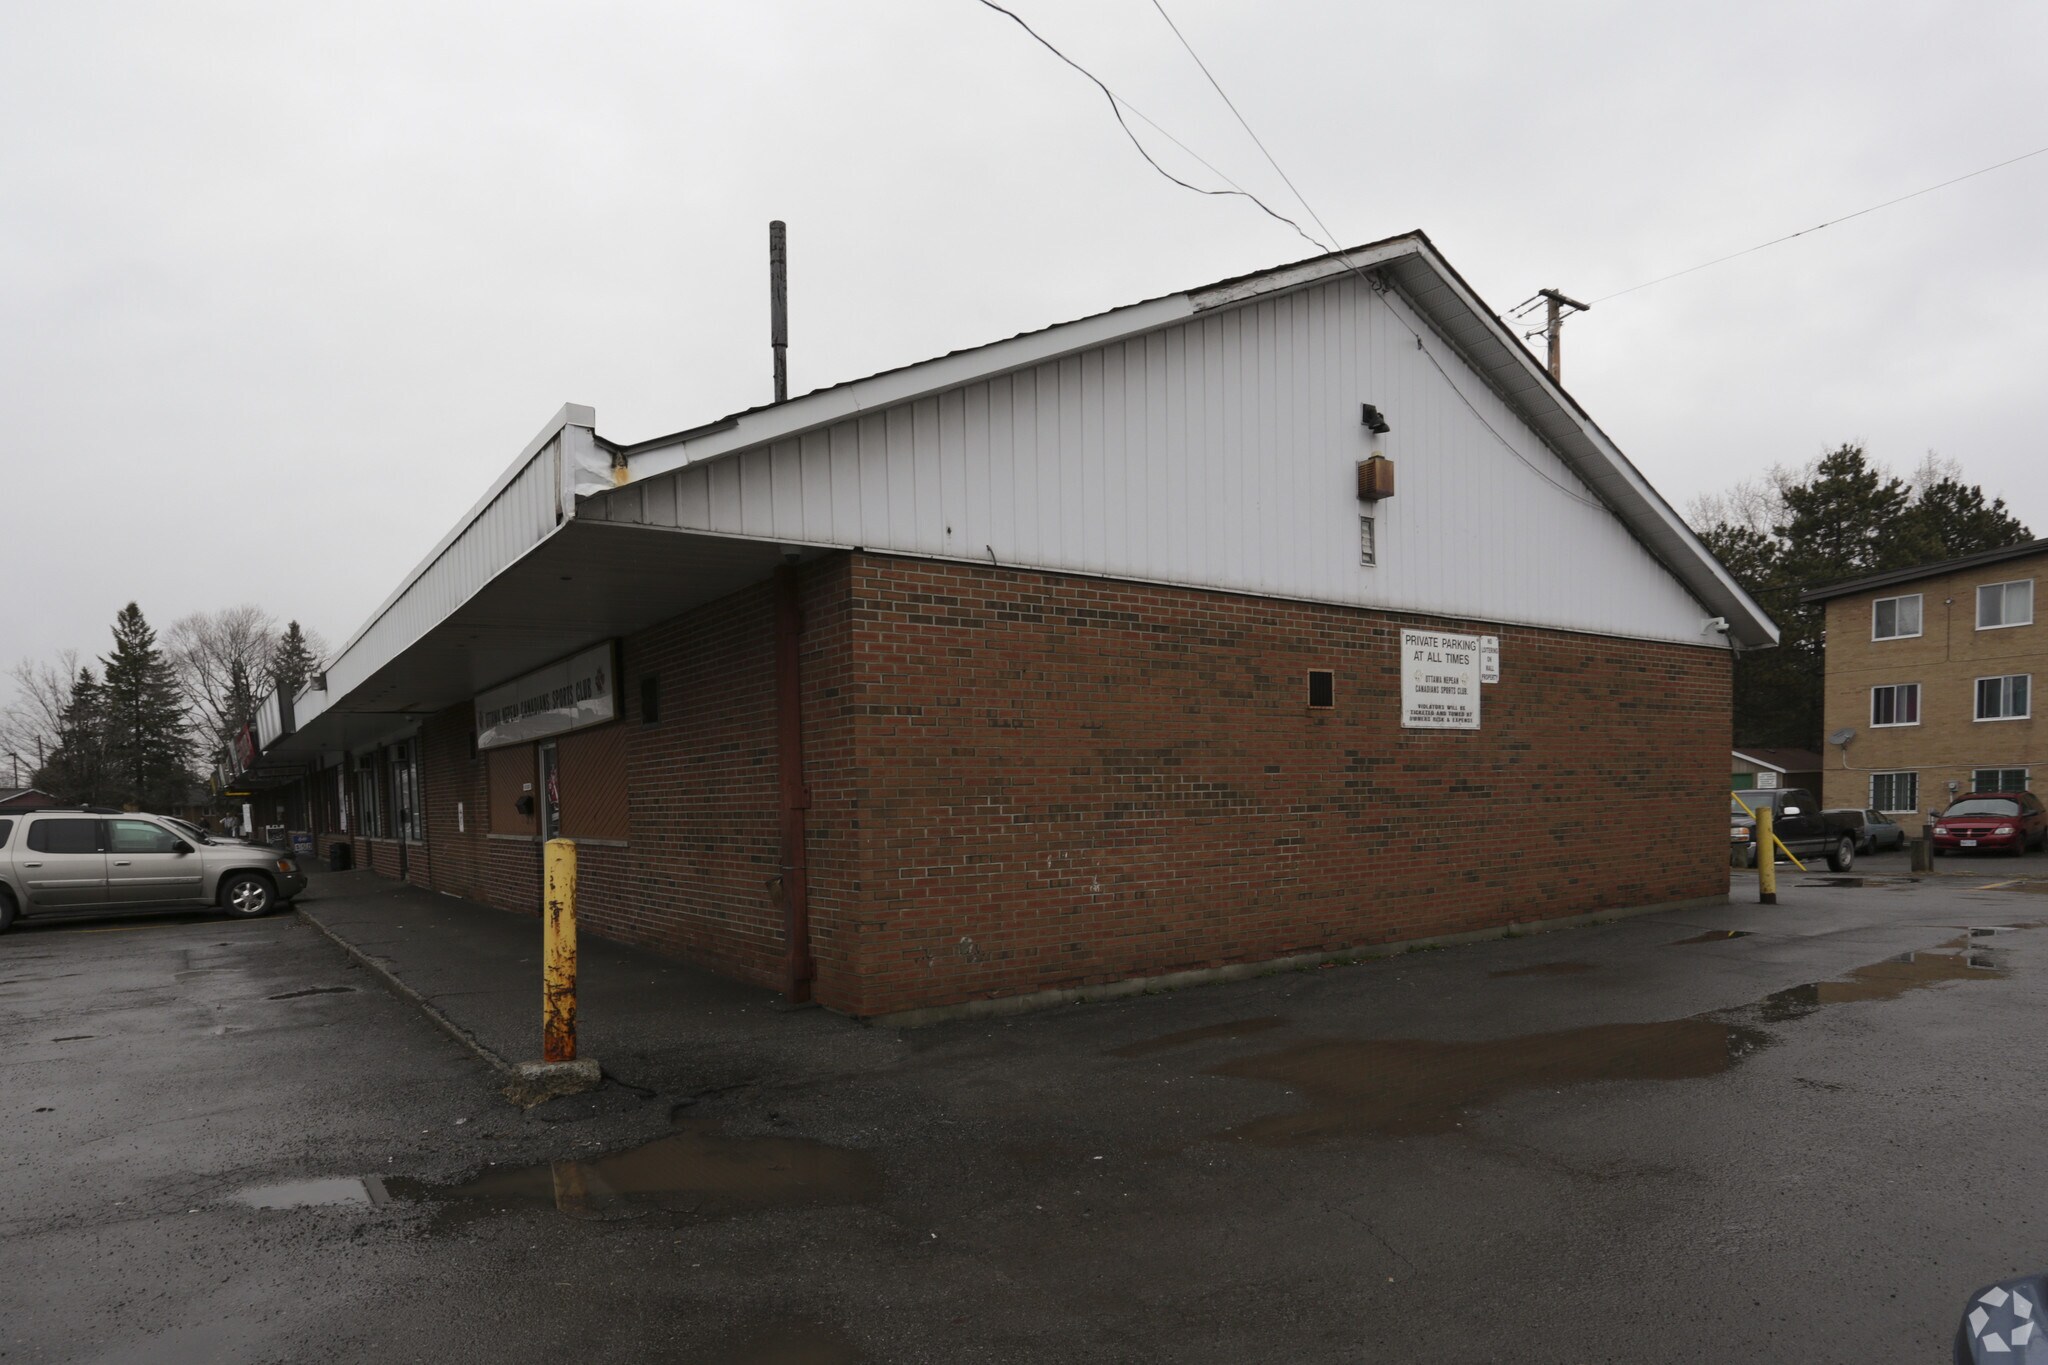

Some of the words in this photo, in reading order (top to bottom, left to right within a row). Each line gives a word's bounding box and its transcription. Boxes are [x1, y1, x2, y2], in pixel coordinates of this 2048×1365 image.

[1406, 635, 1438, 647] PRIVATE
[1442, 638, 1476, 651] PARKING
[1414, 651, 1424, 661] AT
[1427, 652, 1442, 662] ALL
[1445, 653, 1470, 664] TIMES
[1416, 686, 1439, 694] CANADIANS
[521, 693, 549, 718] CANADIANS
[552, 685, 573, 709] SPORTS
[576, 677, 592, 702] CLUB
